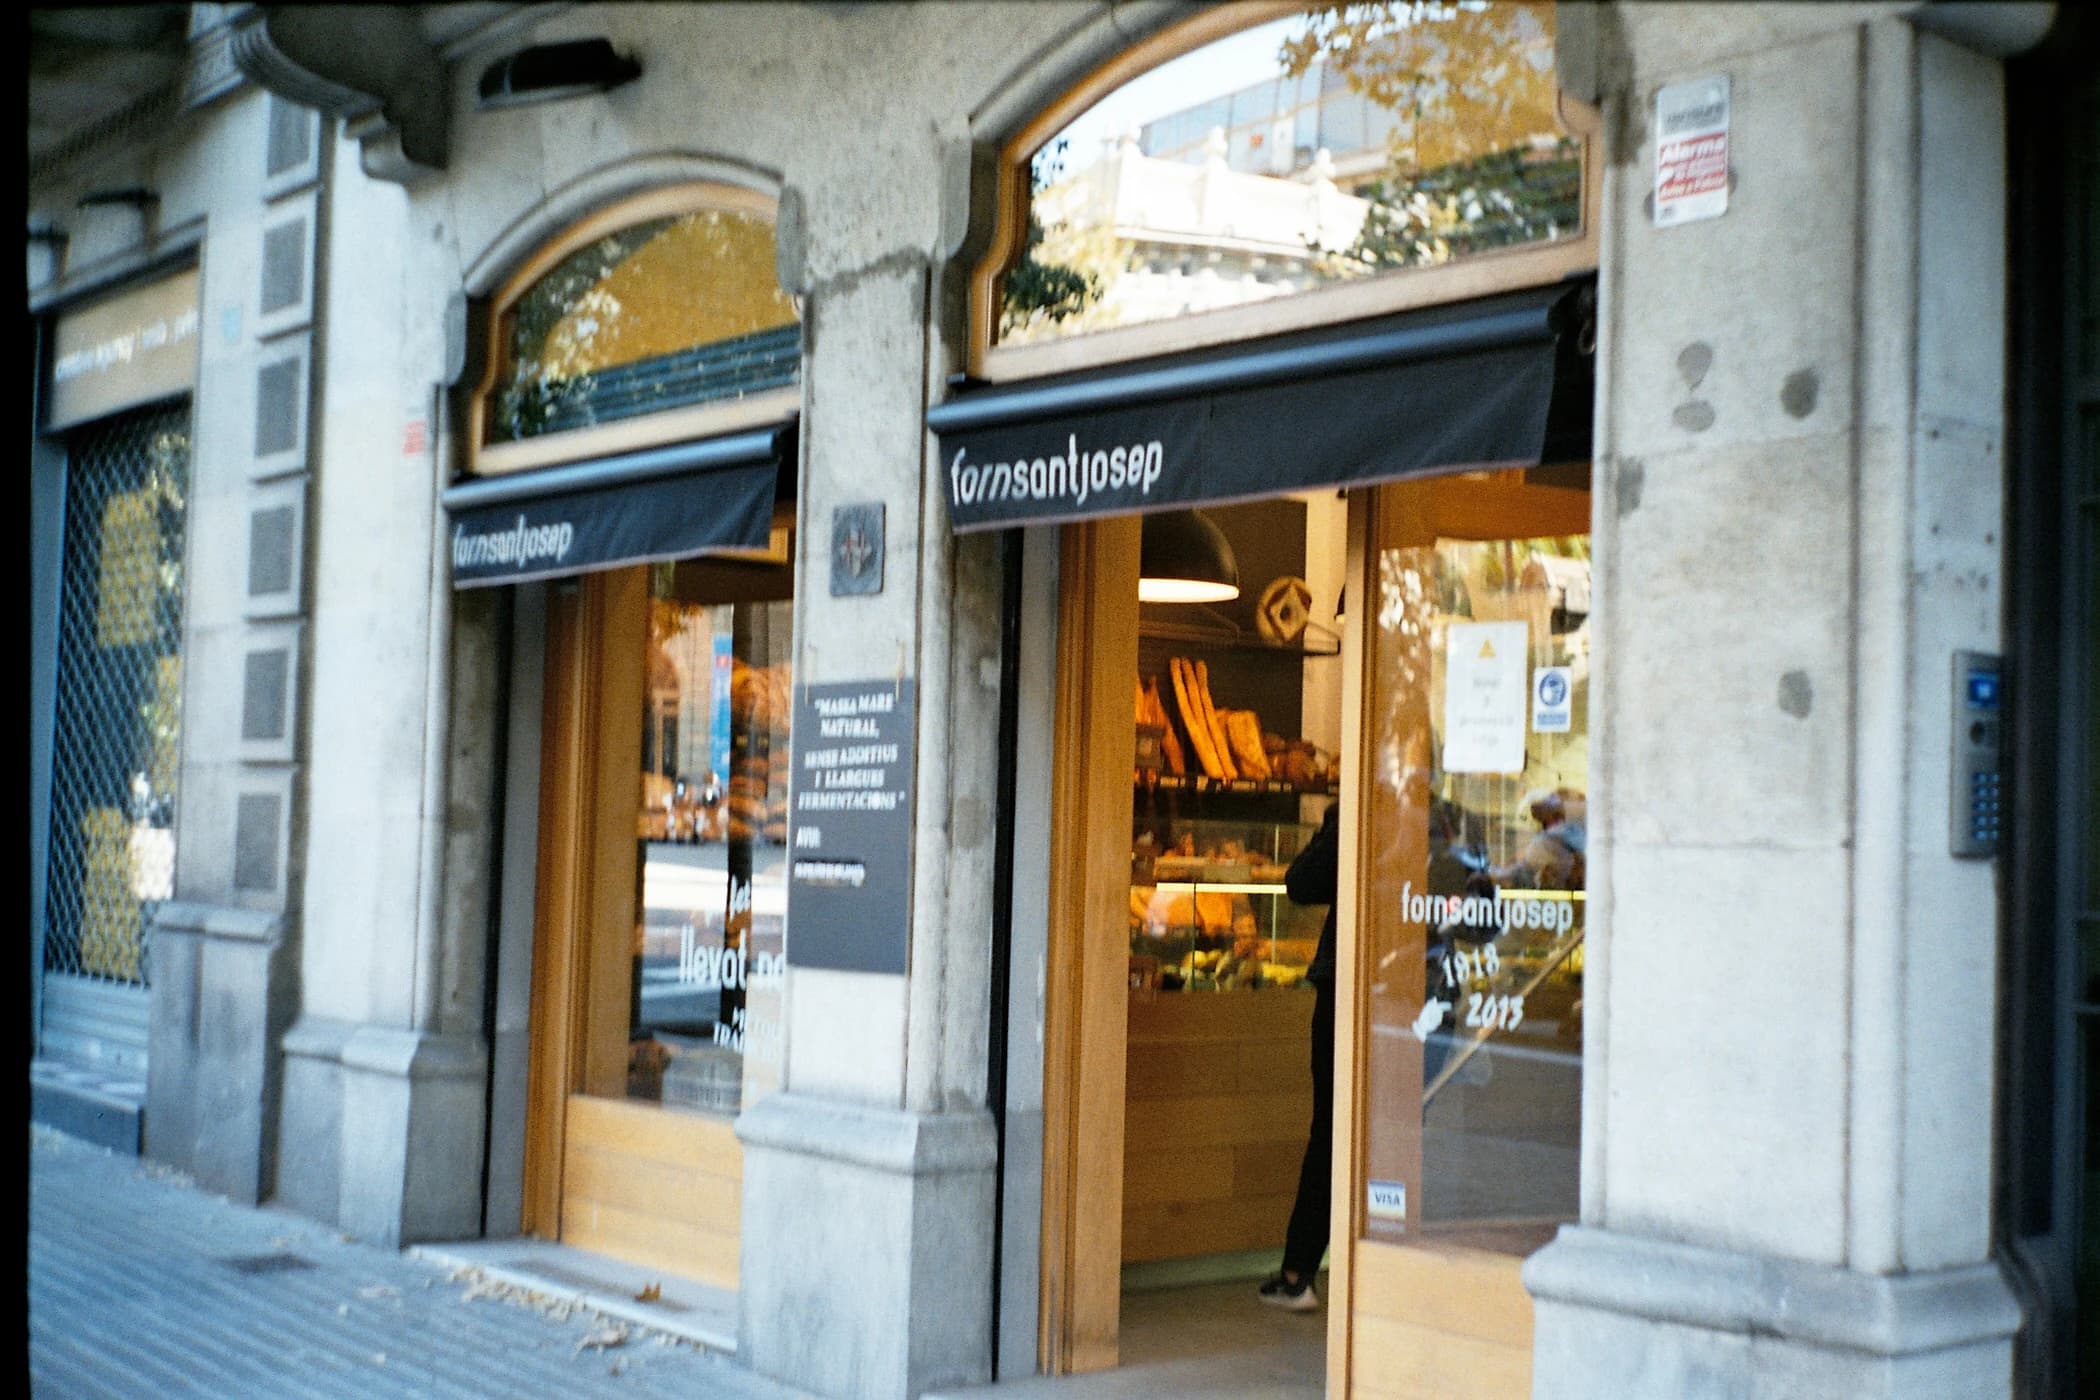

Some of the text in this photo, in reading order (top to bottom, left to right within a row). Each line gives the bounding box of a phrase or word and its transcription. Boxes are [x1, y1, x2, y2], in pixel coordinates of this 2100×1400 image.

[951, 433, 1163, 507] fornsantjosep
[453, 513, 573, 568] fornsantjosep
[1402, 880, 1573, 939] fornsantjosep
[1374, 1191, 1401, 1206] VISA
